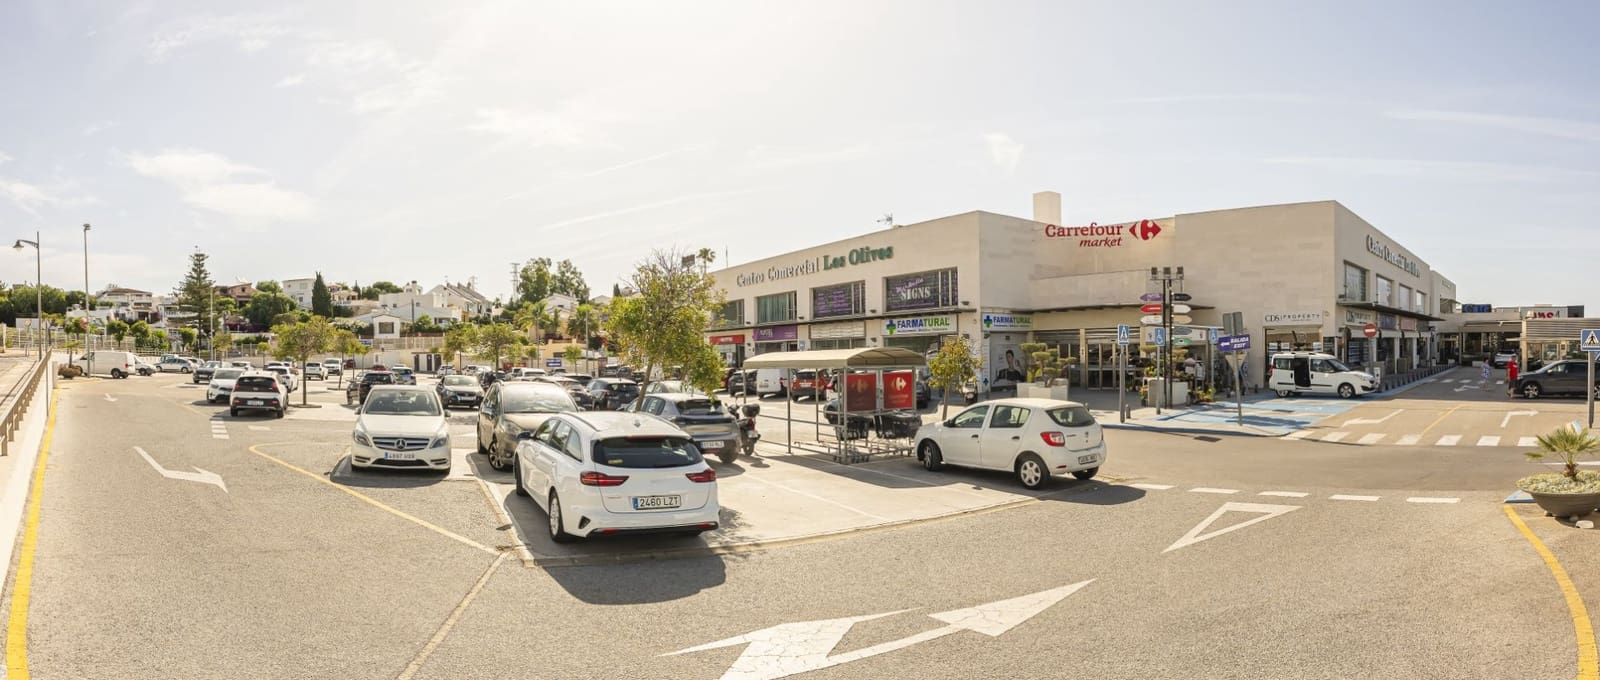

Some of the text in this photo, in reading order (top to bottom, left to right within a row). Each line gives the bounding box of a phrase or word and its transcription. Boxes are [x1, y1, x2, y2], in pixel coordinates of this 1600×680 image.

[1045, 222, 1123, 237] Carrefour
[1079, 237, 1122, 247] market
[736, 272, 765, 287] Centro
[768, 257, 819, 281] Comercial
[823, 255, 846, 270] Los
[901, 286, 930, 300] SIGNS
[897, 317, 950, 329] FARMATURAL
[1264, 314, 1280, 322] CDS
[663, 496, 678, 506] LZT
